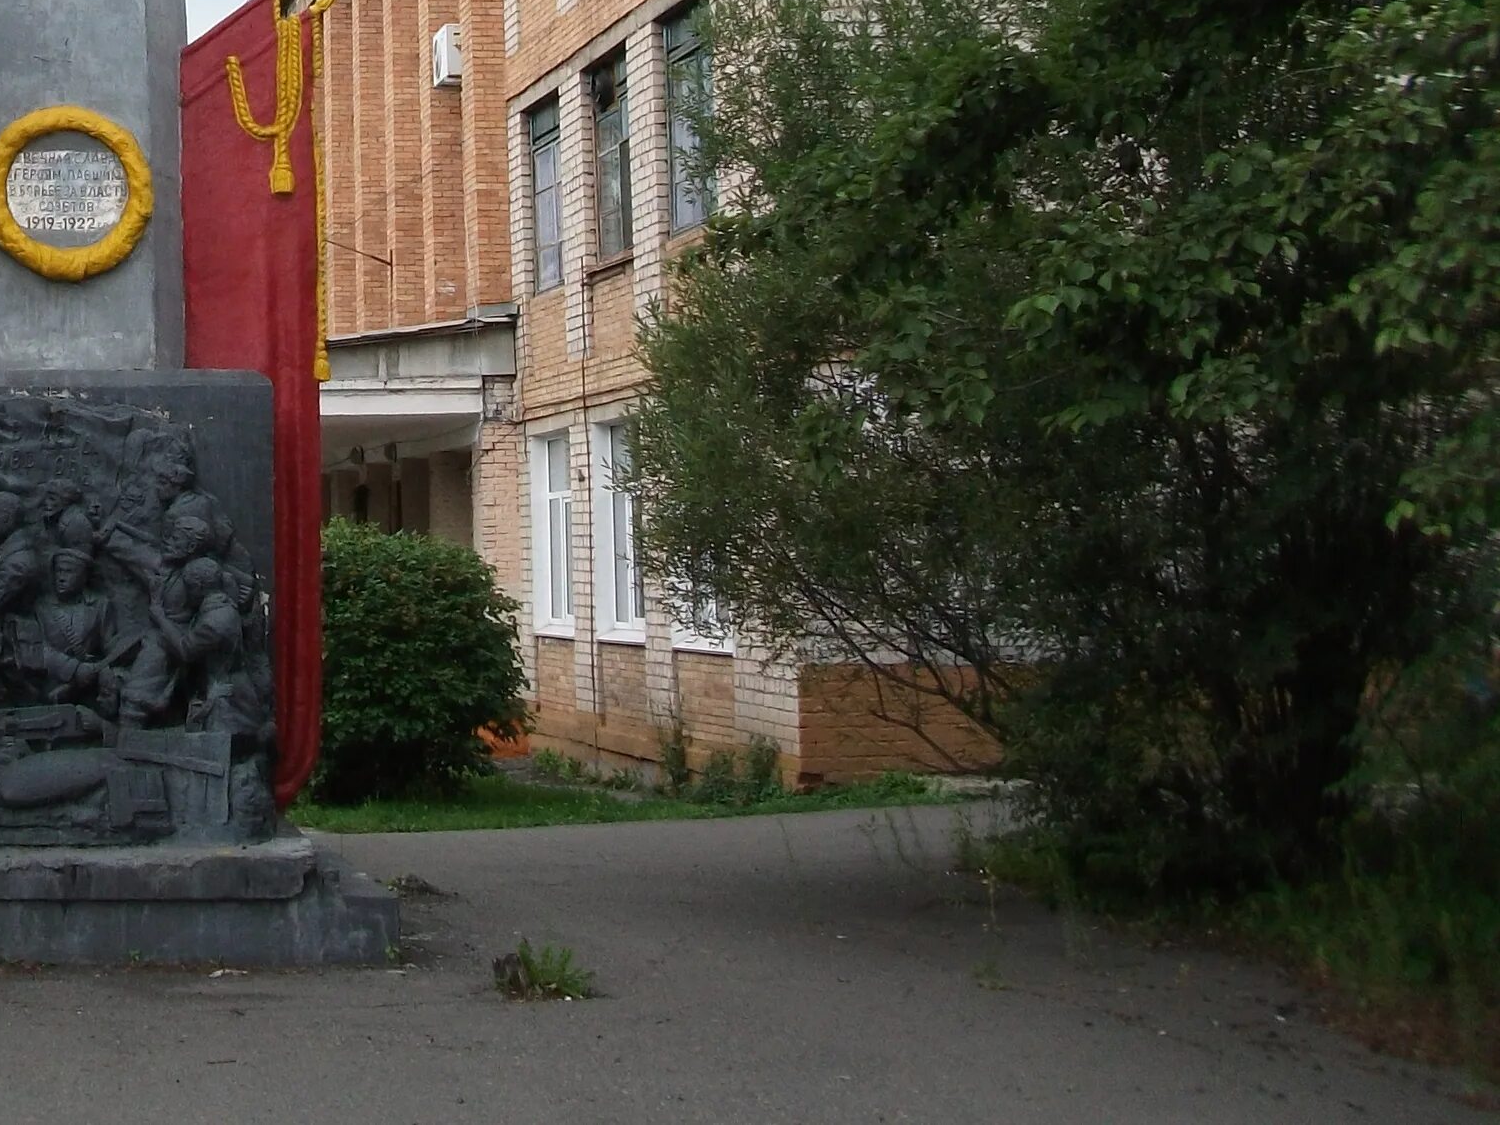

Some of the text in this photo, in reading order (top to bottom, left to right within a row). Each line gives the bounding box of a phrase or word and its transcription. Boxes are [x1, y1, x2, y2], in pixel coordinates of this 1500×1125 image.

[80, 184, 129, 197] ВЛАСТЬ
[39, 201, 95, 213] СОВЕТОВ
[26, 216, 96, 230] 1919-1922
